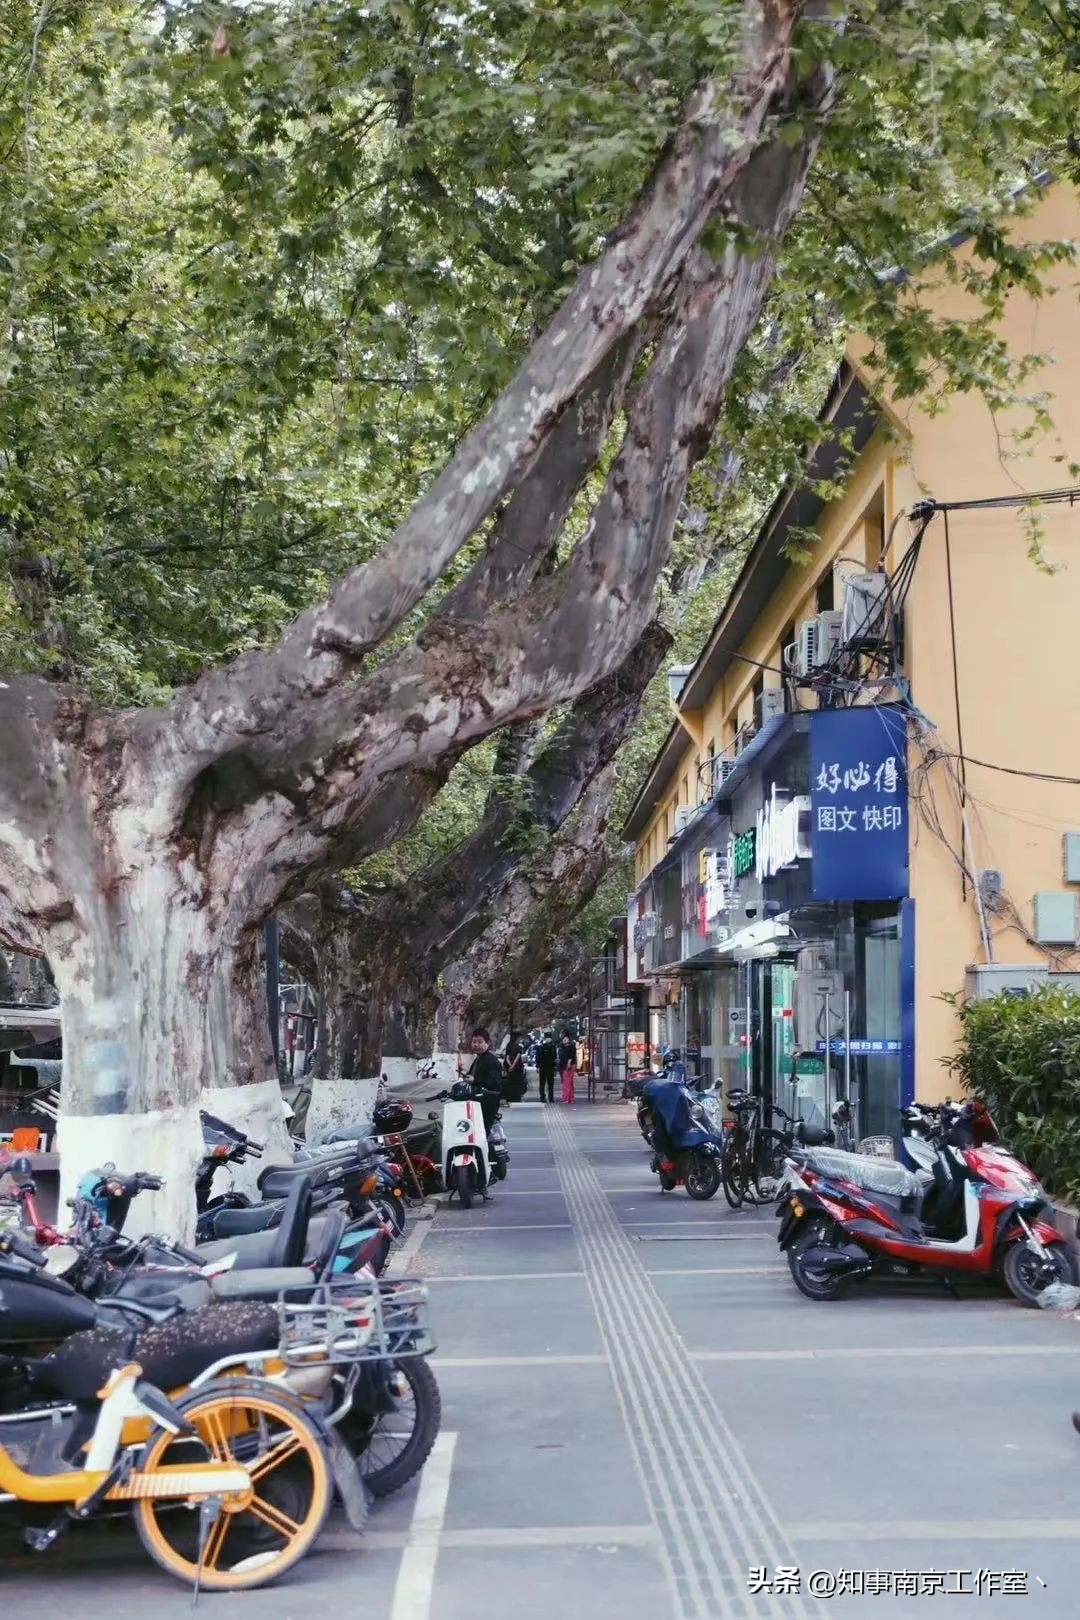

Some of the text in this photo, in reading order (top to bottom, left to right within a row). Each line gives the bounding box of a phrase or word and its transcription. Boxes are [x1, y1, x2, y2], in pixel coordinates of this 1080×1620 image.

[815, 756, 900, 795] 好必得
[817, 804, 902, 832] 图文 快印
